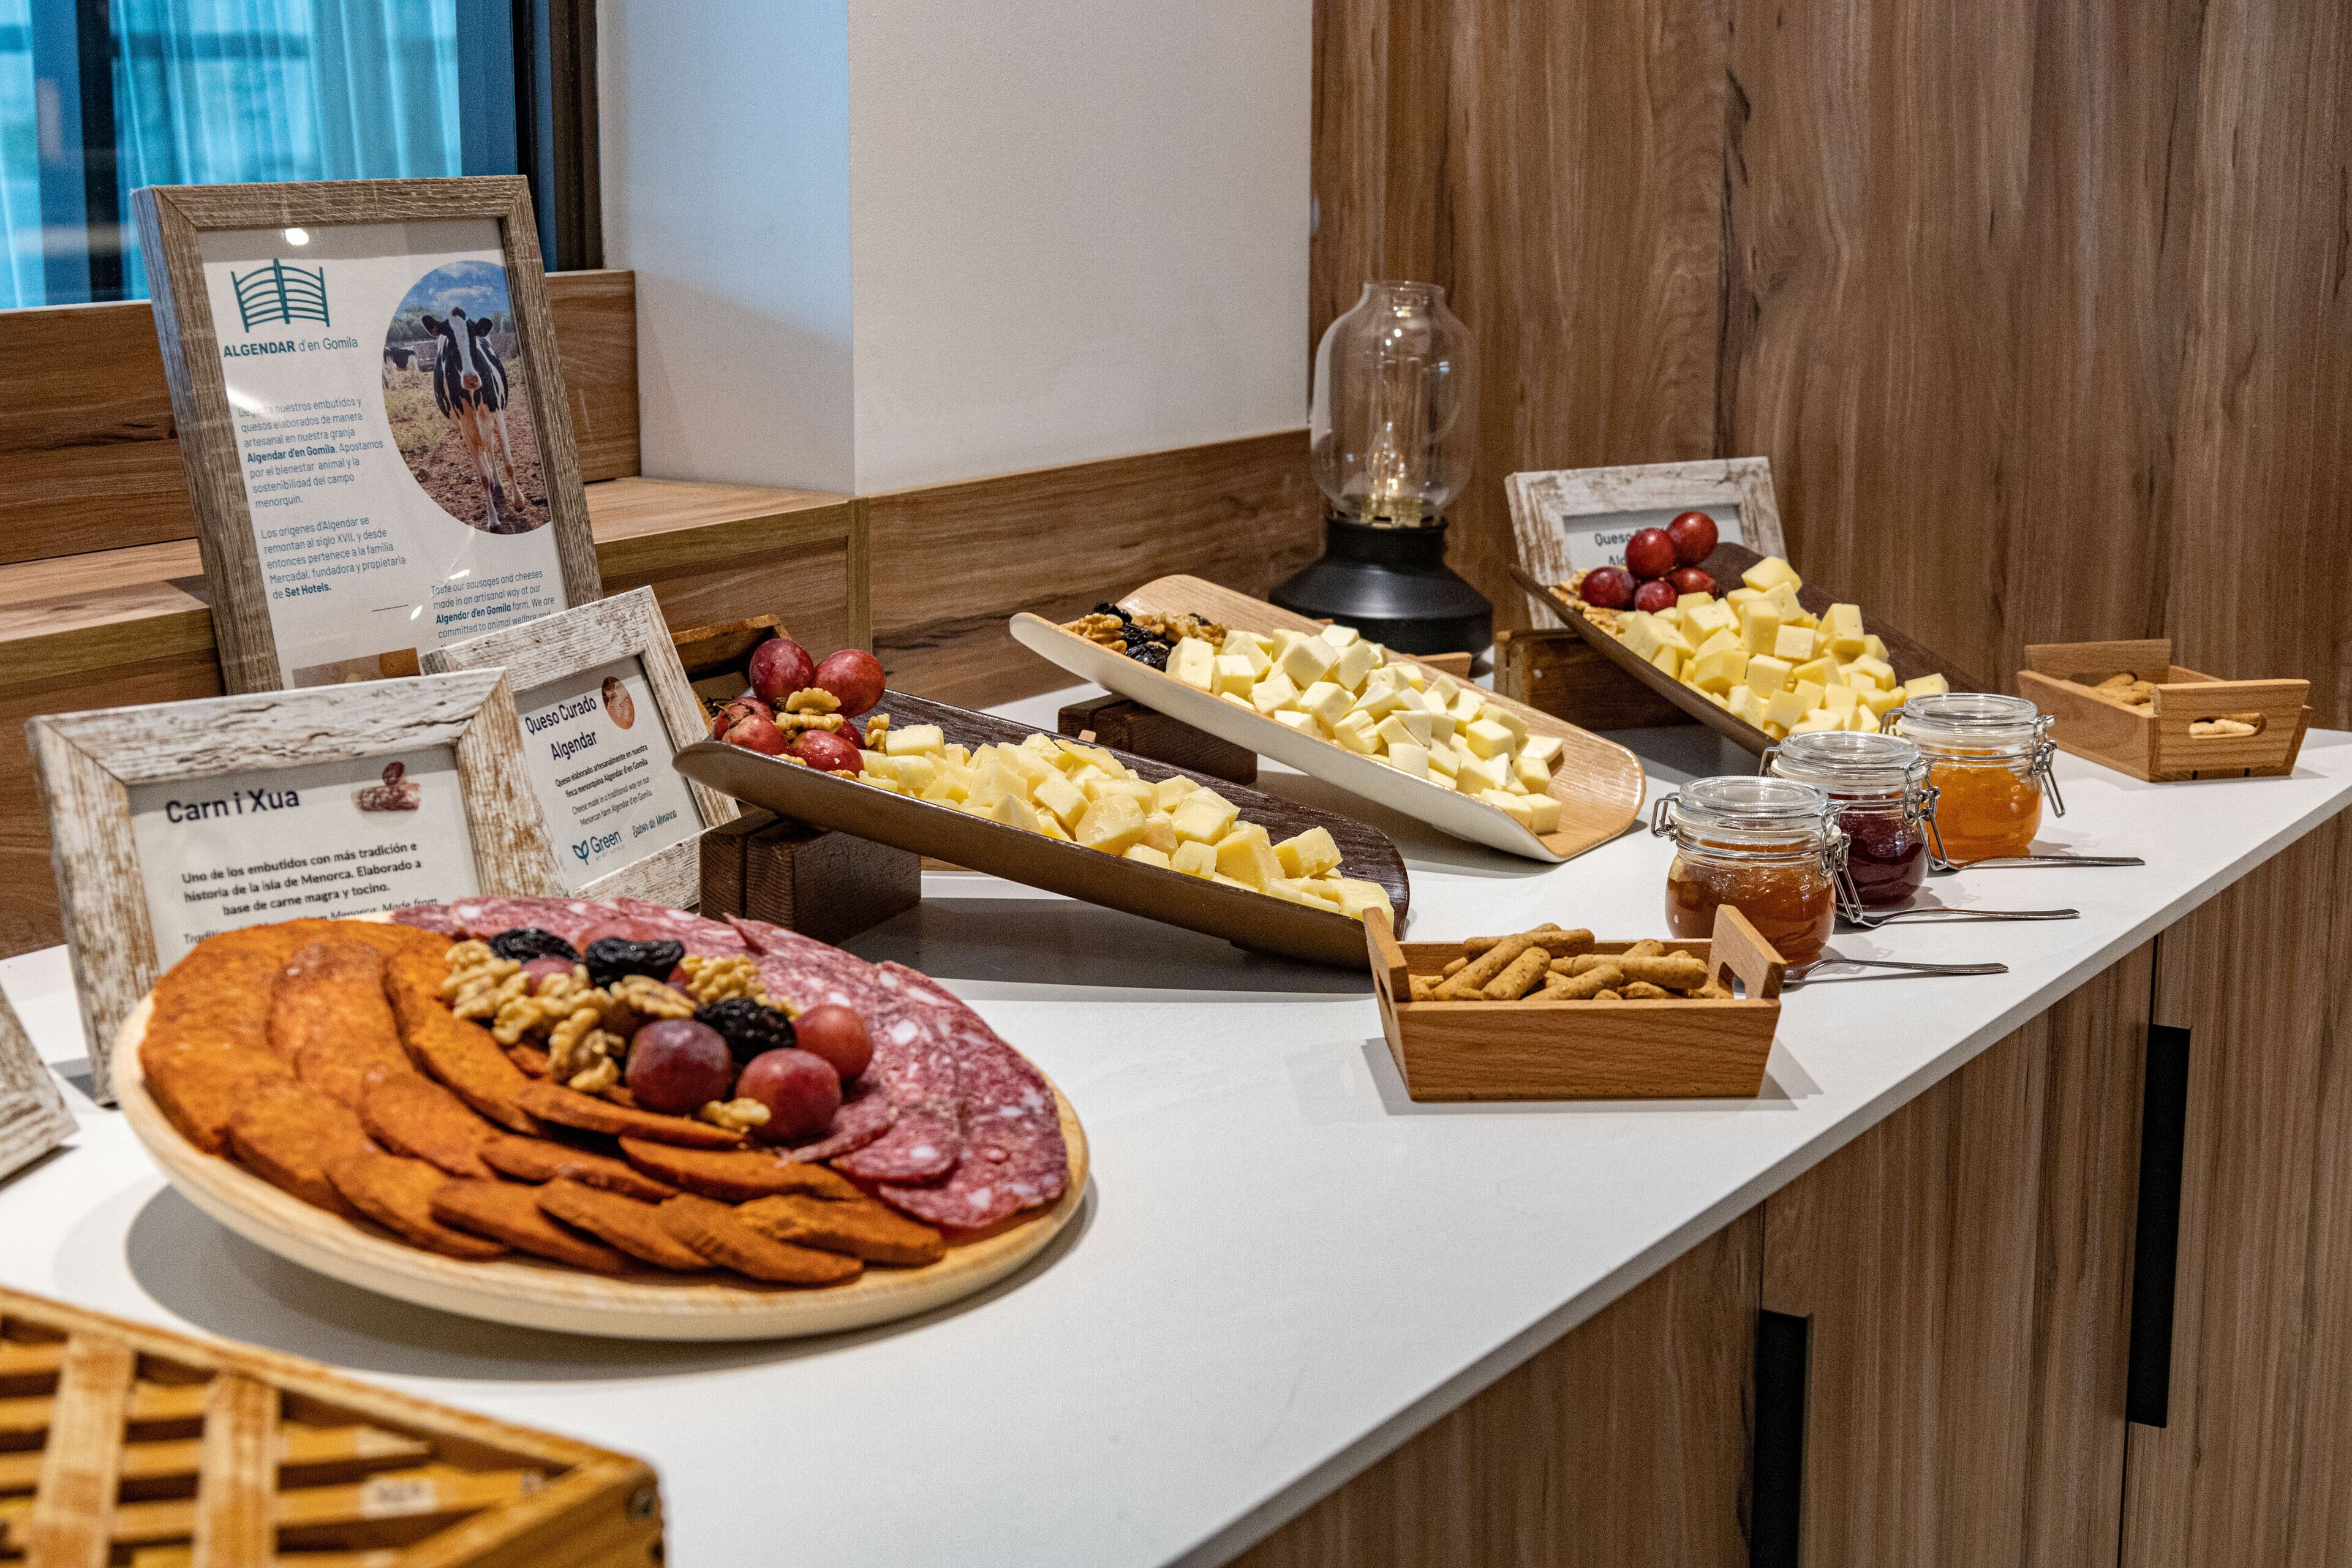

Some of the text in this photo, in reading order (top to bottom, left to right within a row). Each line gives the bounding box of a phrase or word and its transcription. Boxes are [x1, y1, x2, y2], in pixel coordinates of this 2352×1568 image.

[224, 341, 296, 357] ALGENDAR
[323, 337, 358, 349] Gomila
[275, 402, 312, 413] nuestros
[313, 398, 355, 410] embutidos
[356, 398, 362, 408] y
[241, 412, 363, 432] quesos elaborados de manera
[244, 428, 355, 448] artesanal en nuestra granja
[247, 440, 383, 464] Algendar d'en Gomila. Apostamos
[250, 457, 360, 480] por el bienestar animal y la
[252, 473, 355, 494] sostenibilidad del campo
[261, 529, 277, 539] Los
[317, 518, 358, 532] d'Algendar
[360, 516, 369, 526] se
[264, 541, 305, 554] remontan
[307, 538, 314, 548] al
[315, 535, 335, 548] siglo
[356, 532, 361, 542] y
[363, 529, 387, 540] desde
[267, 556, 306, 569] entonces
[308, 549, 350, 565] pertenece
[358, 546, 366, 556] la
[367, 543, 393, 554] familia
[270, 556, 406, 584] Mercadal, fundadora y propietaria
[431, 570, 543, 595] Taste our sausages and cheeses
[273, 582, 331, 599] de Set Hotels.
[434, 598, 454, 609] made
[456, 596, 462, 605] in
[464, 595, 472, 605] an
[474, 590, 505, 603] artisanal
[507, 589, 520, 598] way
[530, 584, 541, 594] our
[436, 597, 554, 624] Algendar d'en Gomila farm. We are
[439, 624, 478, 638] committed
[479, 622, 486, 631] to
[488, 617, 510, 630] animal
[512, 613, 537, 625] welfare
[525, 695, 597, 735] Queso Curado
[551, 731, 597, 760] Algendar
[555, 776, 571, 787] Queso
[571, 766, 594, 781] elaborado
[593, 754, 626, 772] artesanalmente
[631, 744, 648, 756] nuestra
[565, 788, 578, 798] finca
[578, 778, 604, 793] menorquina
[603, 769, 623, 782] Algendar
[632, 758, 648, 769] Gomila
[165, 788, 300, 823] Carn i Xua
[572, 804, 587, 815] Cheese
[587, 797, 600, 808] made
[611, 800, 629, 813] Algendar
[637, 789, 652, 801] Gomila
[590, 831, 622, 853] Green
[181, 872, 207, 884] Uno
[210, 869, 224, 880] de
[227, 866, 244, 877] los
[247, 858, 307, 875] embutidos
[310, 854, 331, 865] con
[333, 850, 356, 862] más
[358, 842, 407, 858] tradición
[184, 888, 228, 902] historia
[232, 884, 246, 895] de
[249, 882, 259, 893] la
[262, 878, 281, 891] isla
[284, 876, 298, 888] de
[300, 872, 353, 885] Menorca.
[356, 860, 412, 876] Elaborado
[222, 883, 390, 916] base de carne magra y tocino.
